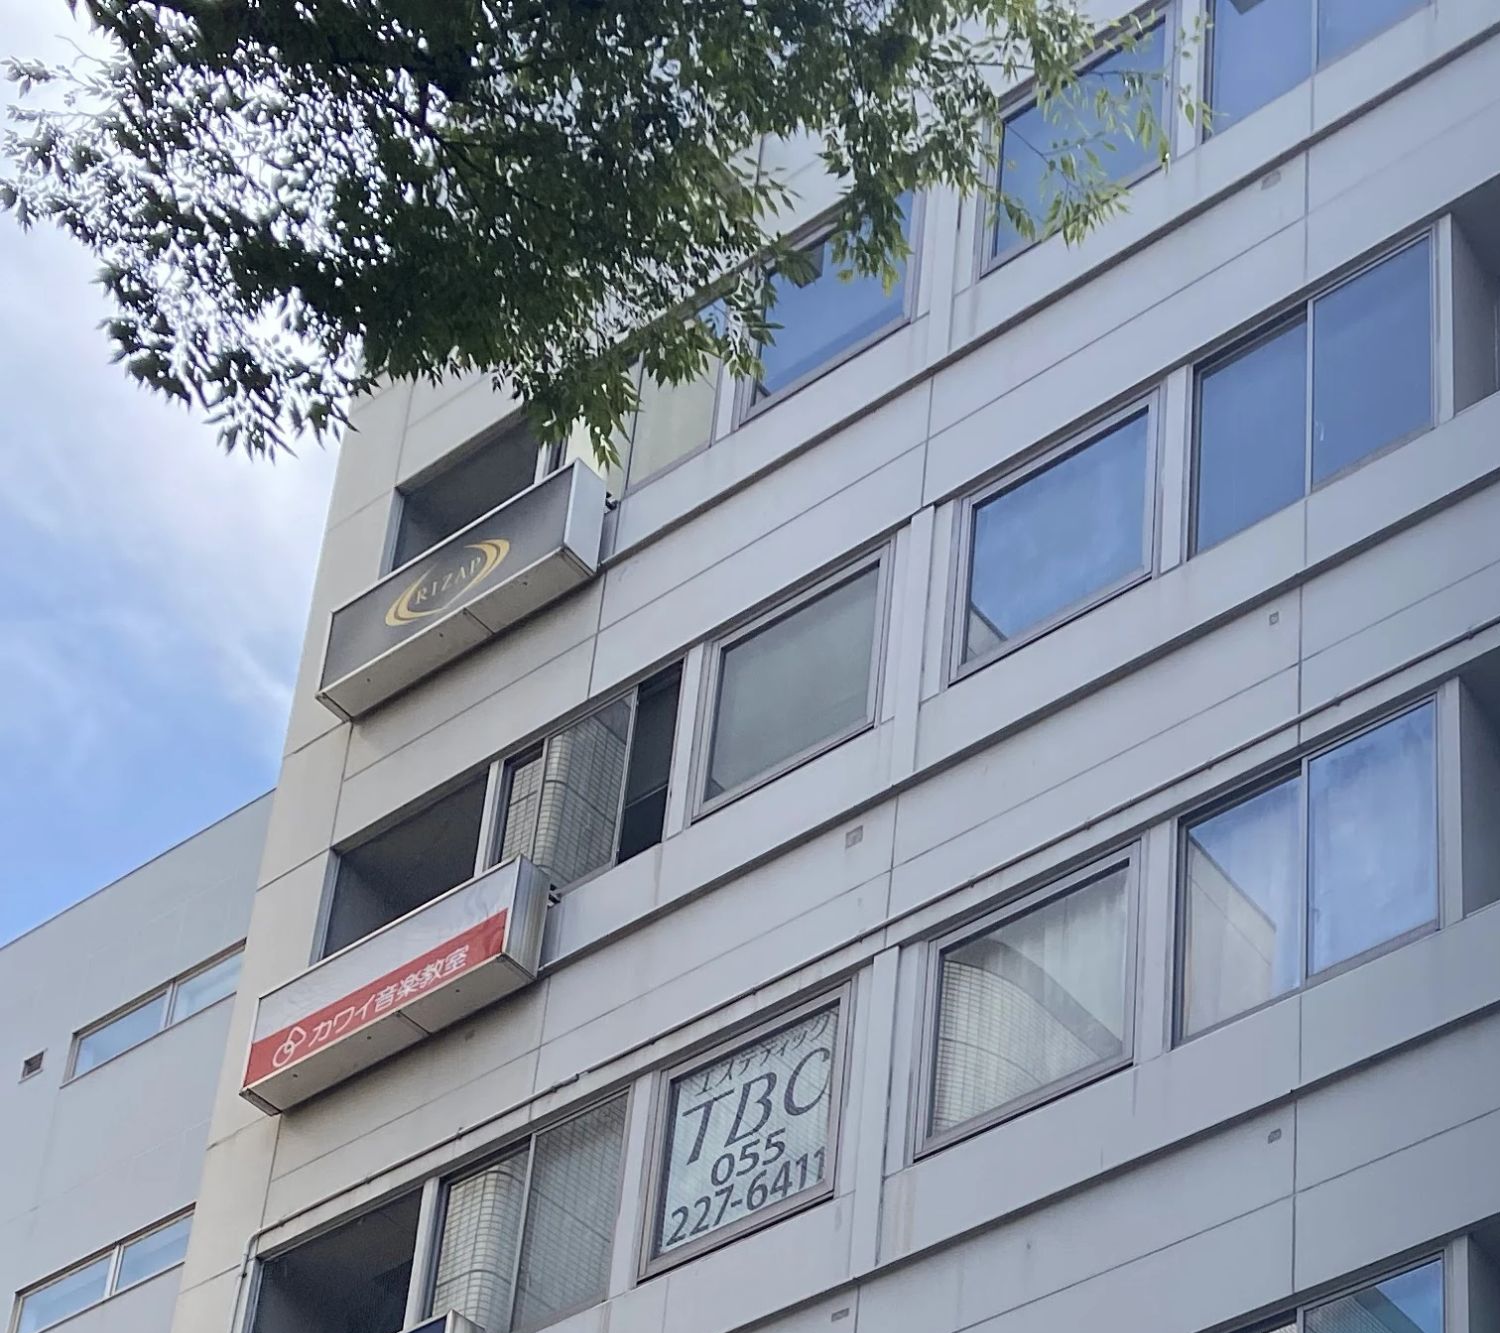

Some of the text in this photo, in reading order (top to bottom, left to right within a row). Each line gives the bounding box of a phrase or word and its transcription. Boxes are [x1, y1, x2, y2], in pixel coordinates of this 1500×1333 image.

[415, 556, 481, 604] RIZAP
[308, 944, 469, 1047] カワイ音楽教室
[682, 1047, 831, 1166] TBC
[710, 1127, 786, 1187] 055
[665, 1146, 826, 1247] 227-6411
